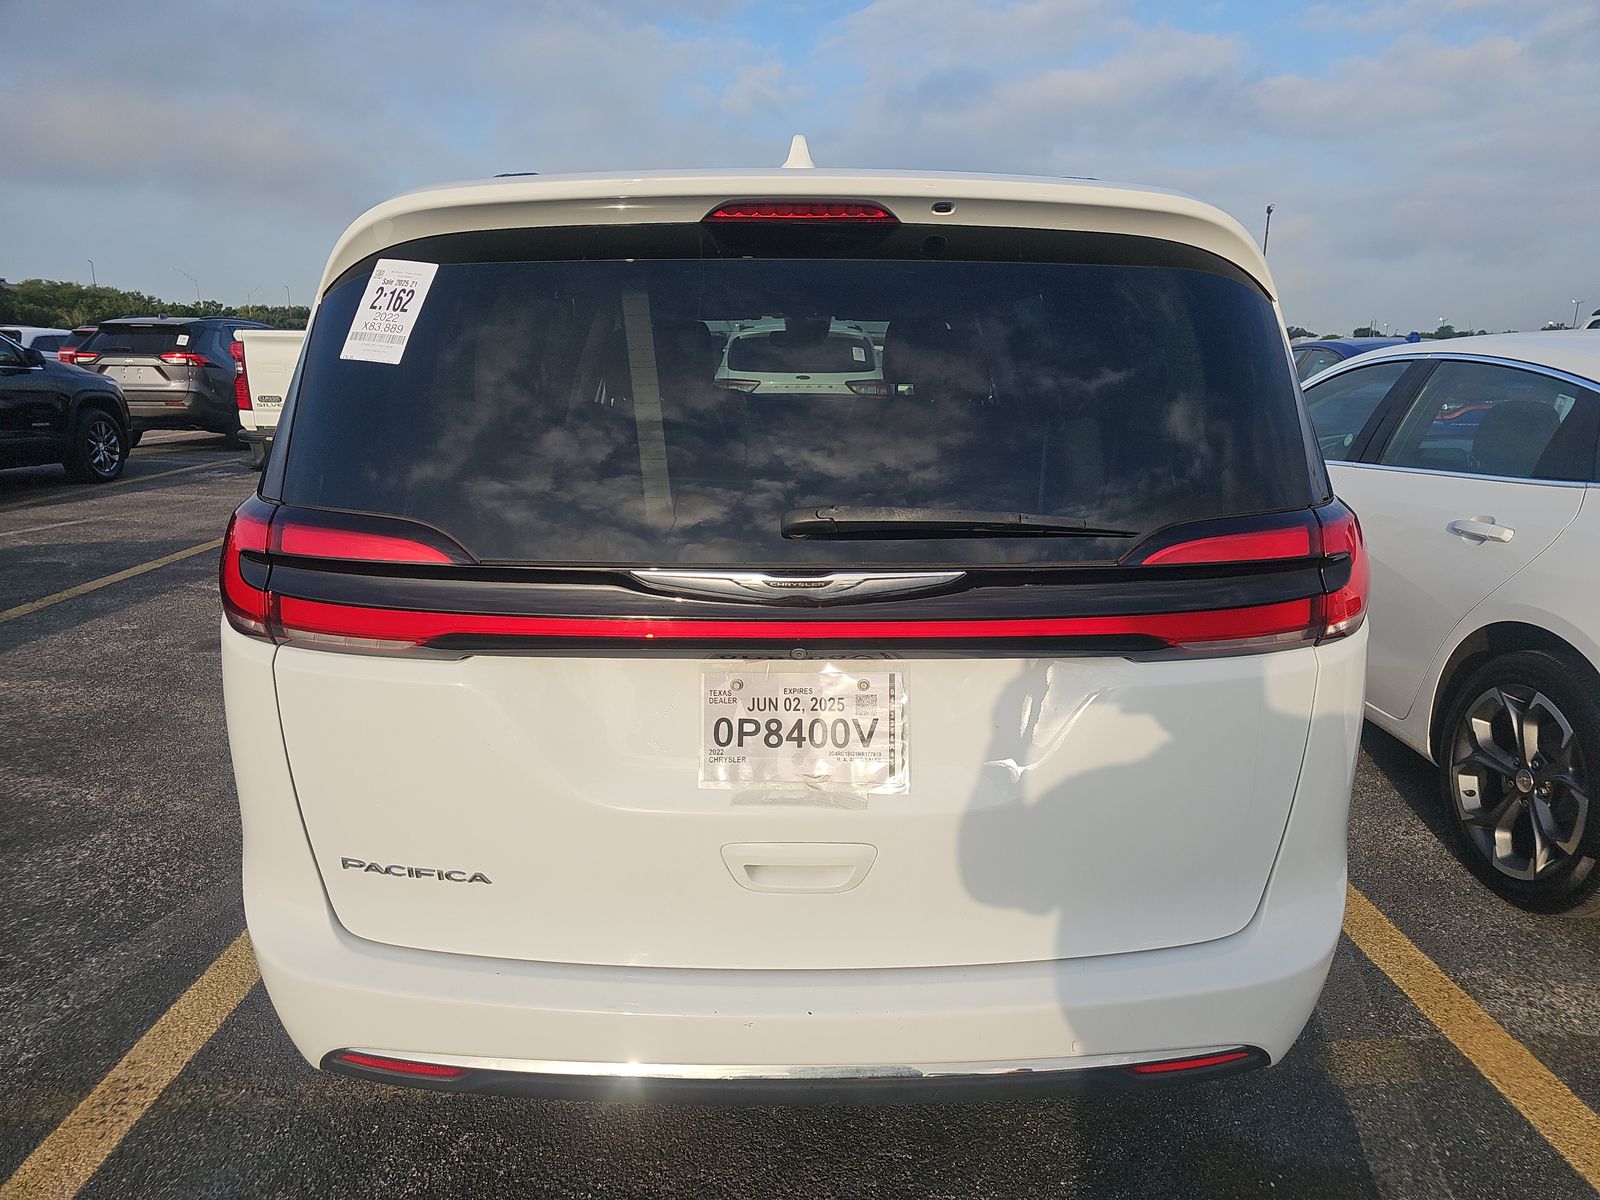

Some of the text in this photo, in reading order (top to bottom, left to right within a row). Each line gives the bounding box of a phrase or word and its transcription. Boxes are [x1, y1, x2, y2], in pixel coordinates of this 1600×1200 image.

[382, 277, 418, 288] Sale 2025 21
[369, 286, 415, 313] 2:162
[373, 312, 399, 323] 2022
[362, 321, 404, 334] X83,889
[709, 689, 732, 697] TEXAS
[783, 687, 813, 695] EXPIRES
[747, 697, 845, 714] JUN 02, 2025
[713, 717, 879, 749] 0P8400V
[709, 756, 747, 764] CHRYSLER
[341, 857, 493, 885] PACIFICA
